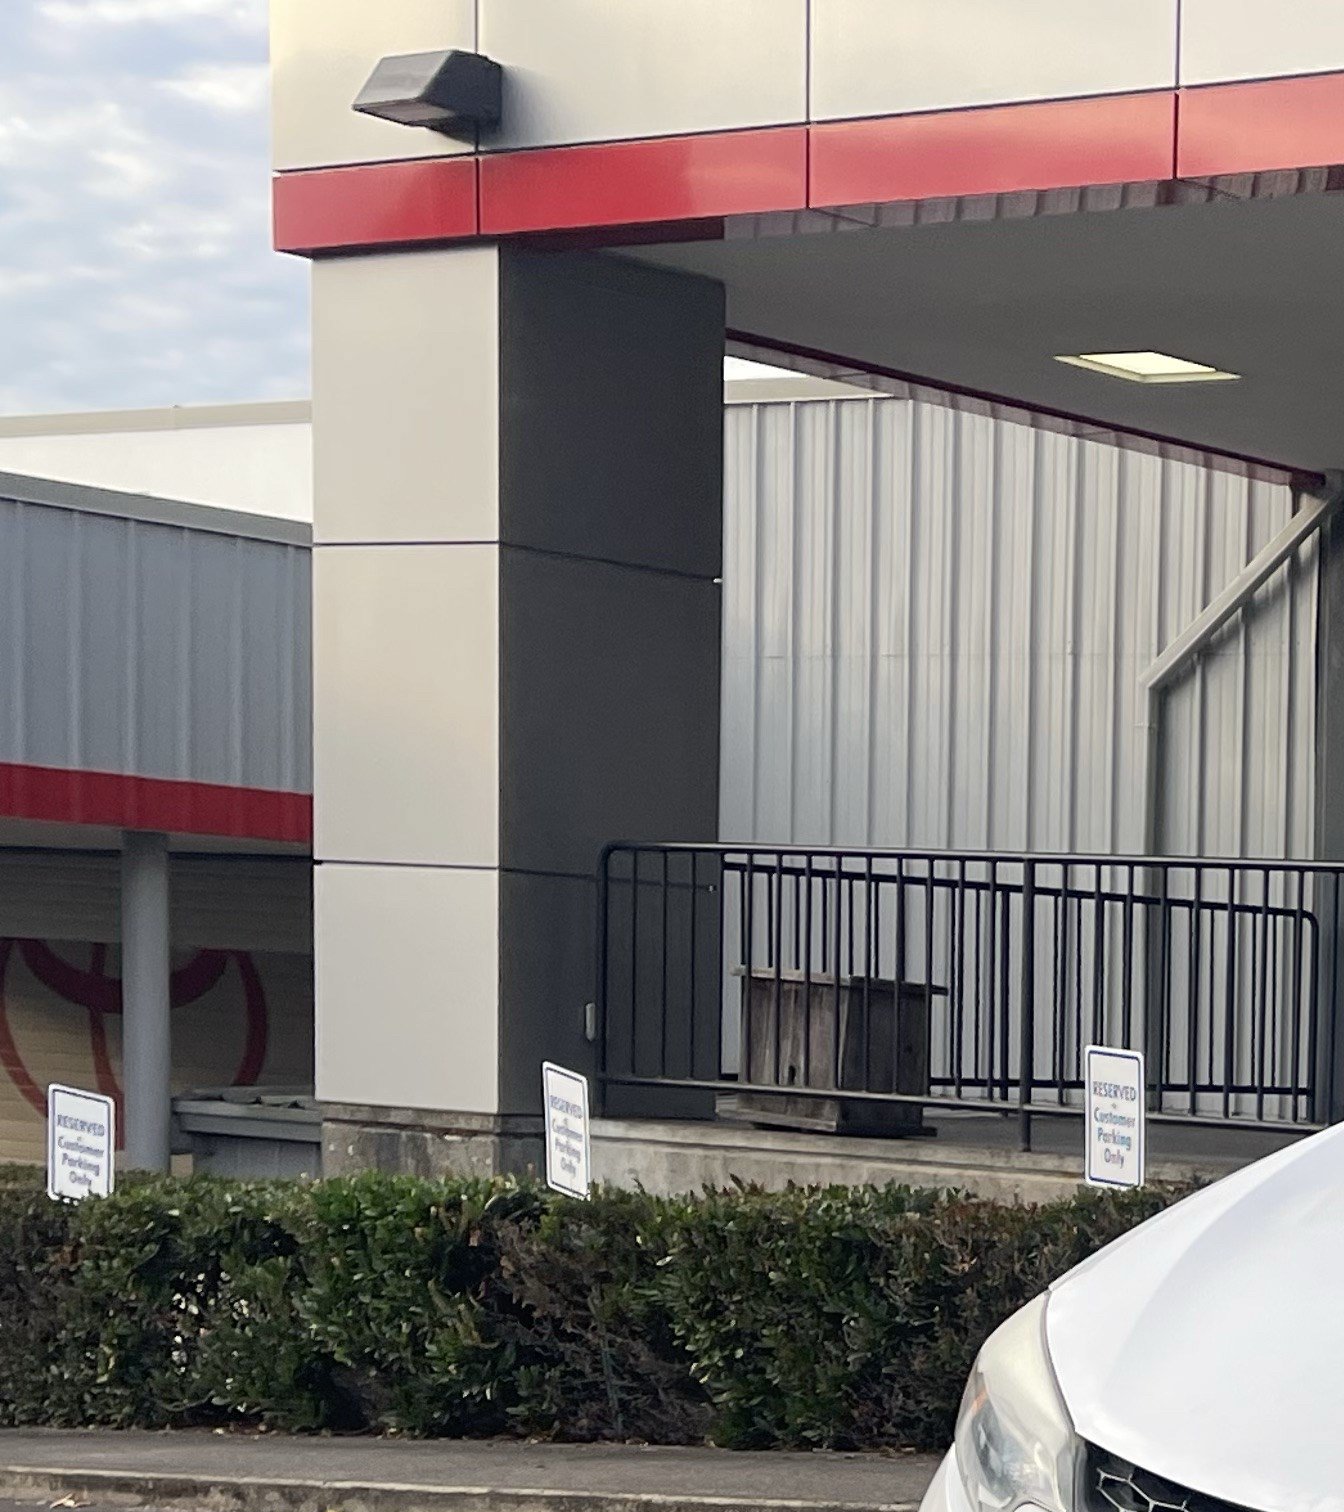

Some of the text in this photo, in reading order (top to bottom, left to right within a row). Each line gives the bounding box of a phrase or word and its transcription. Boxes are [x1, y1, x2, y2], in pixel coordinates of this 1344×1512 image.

[1092, 1081, 1137, 1102] RESERVED
[1094, 1107, 1136, 1129] Customer
[1097, 1127, 1132, 1151] Parking
[1103, 1148, 1125, 1169] Only
